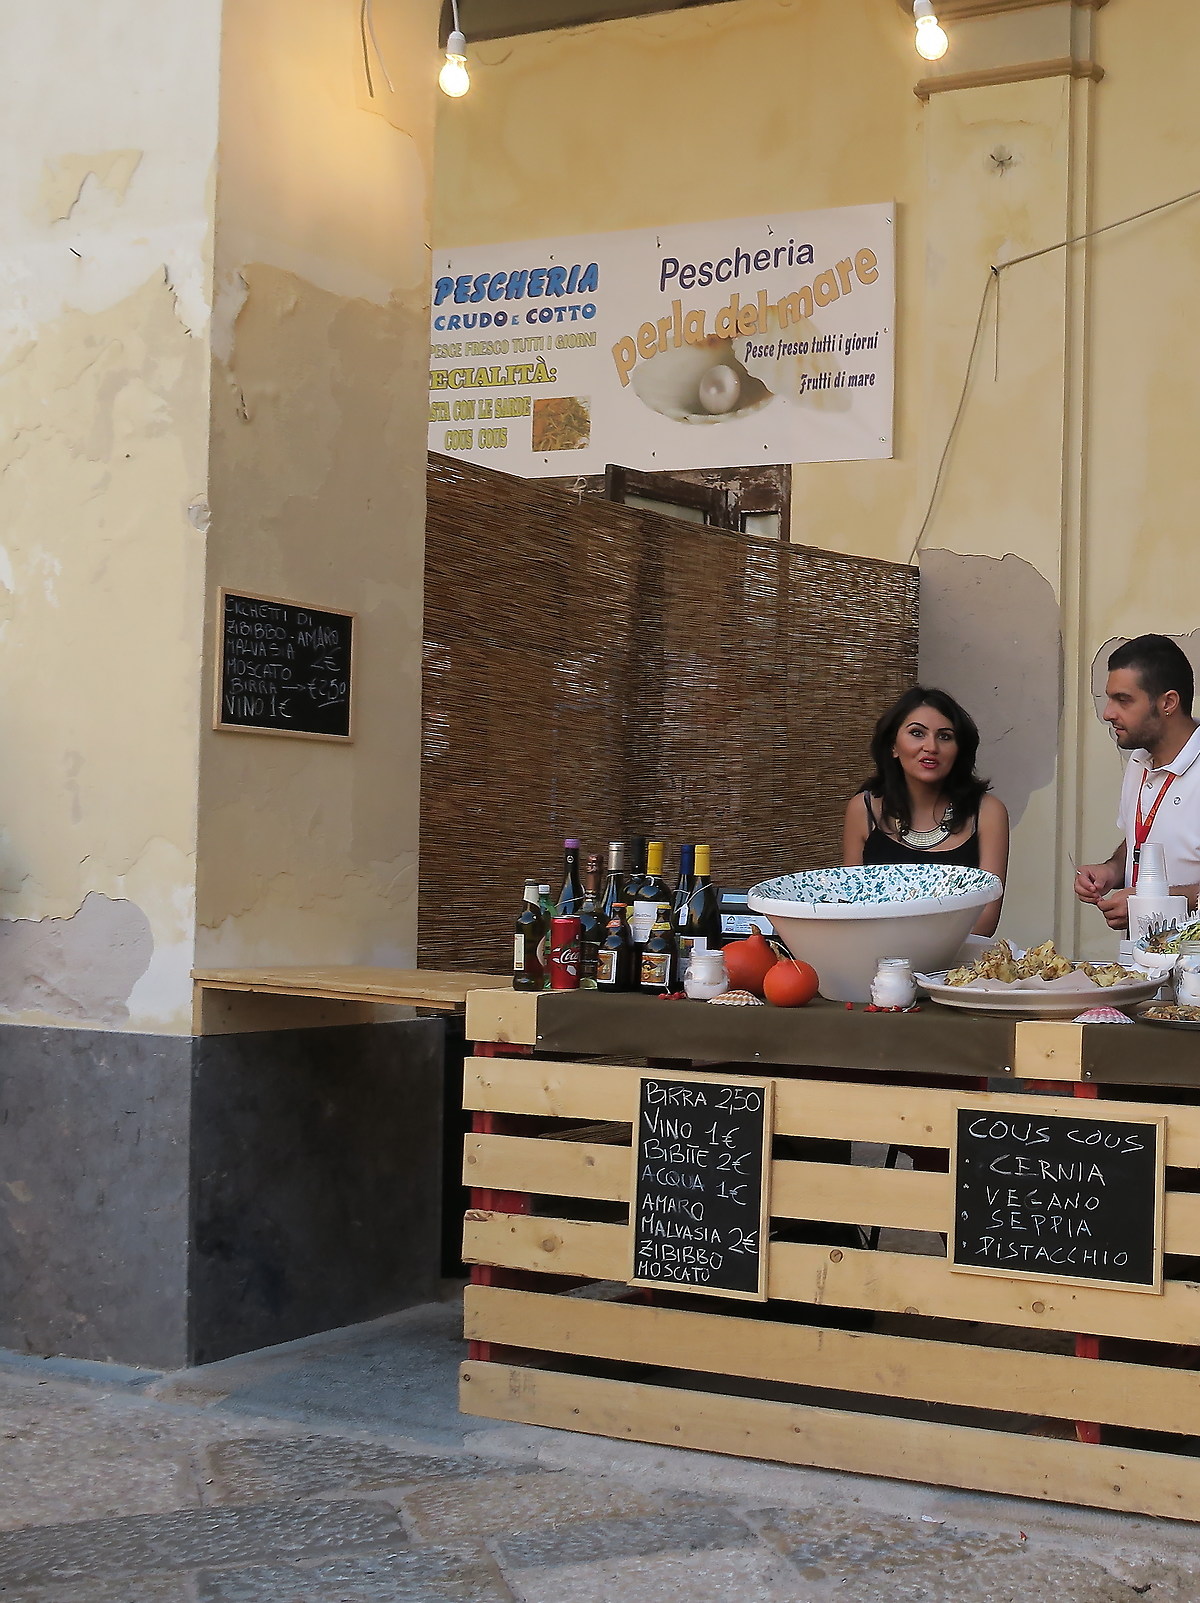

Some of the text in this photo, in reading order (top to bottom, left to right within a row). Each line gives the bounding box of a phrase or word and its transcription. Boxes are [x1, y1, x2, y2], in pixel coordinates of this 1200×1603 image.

[659, 239, 815, 292] Pescheria
[433, 262, 599, 306] PESCHERIA
[434, 303, 597, 331] CRUDO E COTTO
[611, 247, 880, 388] perla del mare
[464, 339, 510, 357] FRESCO
[511, 336, 544, 354] TUTTI
[555, 331, 597, 350] GIORNI
[745, 332, 879, 363] Pesce fresco tutti i giorni
[429, 355, 557, 390] ECIALITÀ:
[799, 371, 875, 394] Frutti di mare
[429, 395, 532, 422] STA CON LE SARDE
[444, 428, 508, 450] COUS COUS
[297, 612, 312, 627] DI
[226, 619, 339, 650] ZIBIBBO AMARO
[227, 658, 292, 681] MOSCATO
[229, 678, 278, 695] BIRRA
[226, 695, 265, 717] VINO
[646, 1081, 707, 1108] BIRRA
[644, 1107, 693, 1140] VINO
[968, 1117, 1145, 1153] COUS COUS
[643, 1138, 710, 1168] BIBITE
[641, 1165, 705, 1192] ACQUA
[989, 1154, 1106, 1187] CERNIA
[642, 1193, 704, 1222] AMARO
[986, 1185, 1100, 1211] VEGANO
[641, 1213, 722, 1244] MALVASIA
[986, 1209, 1092, 1237] SEPPIA
[638, 1239, 724, 1271] ZIBIBBO
[975, 1236, 1128, 1267] PISTACCHIO
[637, 1261, 711, 1282] MOSCATO
